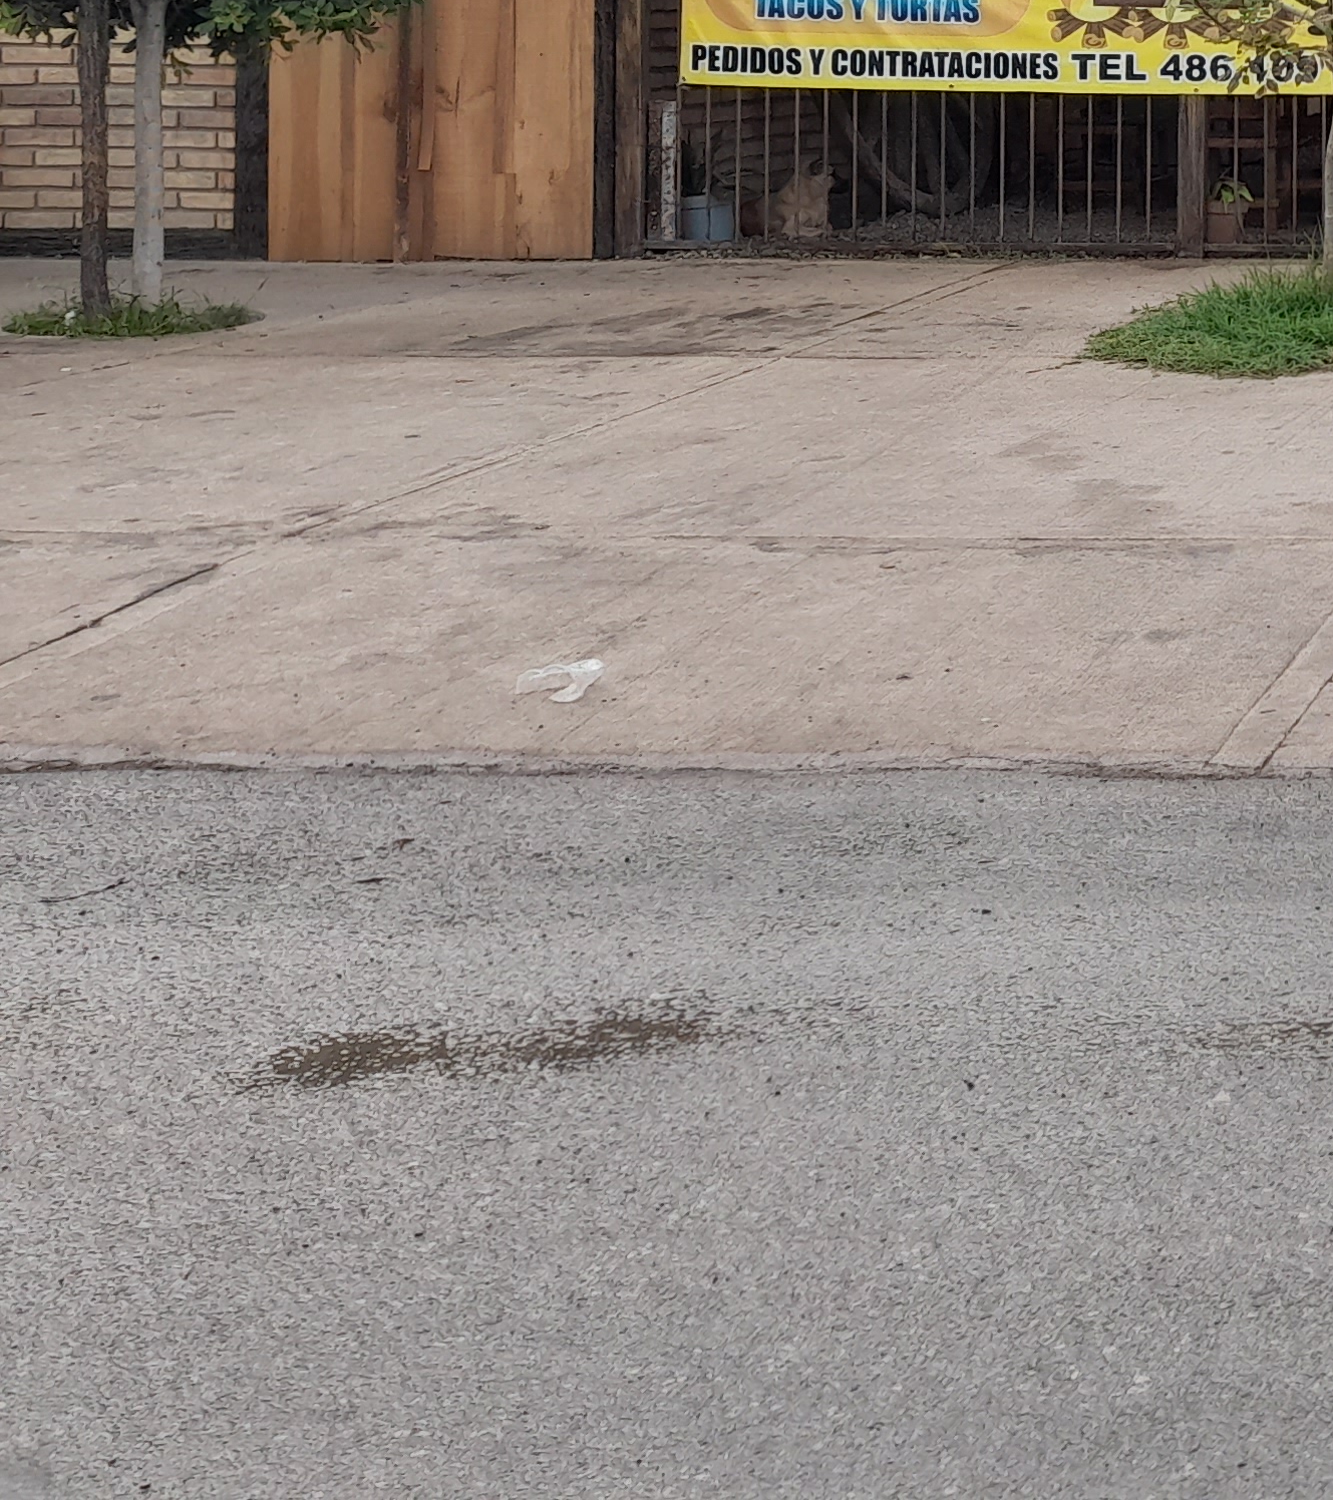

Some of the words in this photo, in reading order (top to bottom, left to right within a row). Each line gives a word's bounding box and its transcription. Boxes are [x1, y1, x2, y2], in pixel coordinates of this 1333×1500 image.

[691, 44, 802, 75] PEDIDOS
[808, 48, 826, 76] Y
[831, 49, 1059, 80] CONTRATACIONES
[1071, 54, 1147, 81] TEL
[1160, 53, 1233, 82] 486
